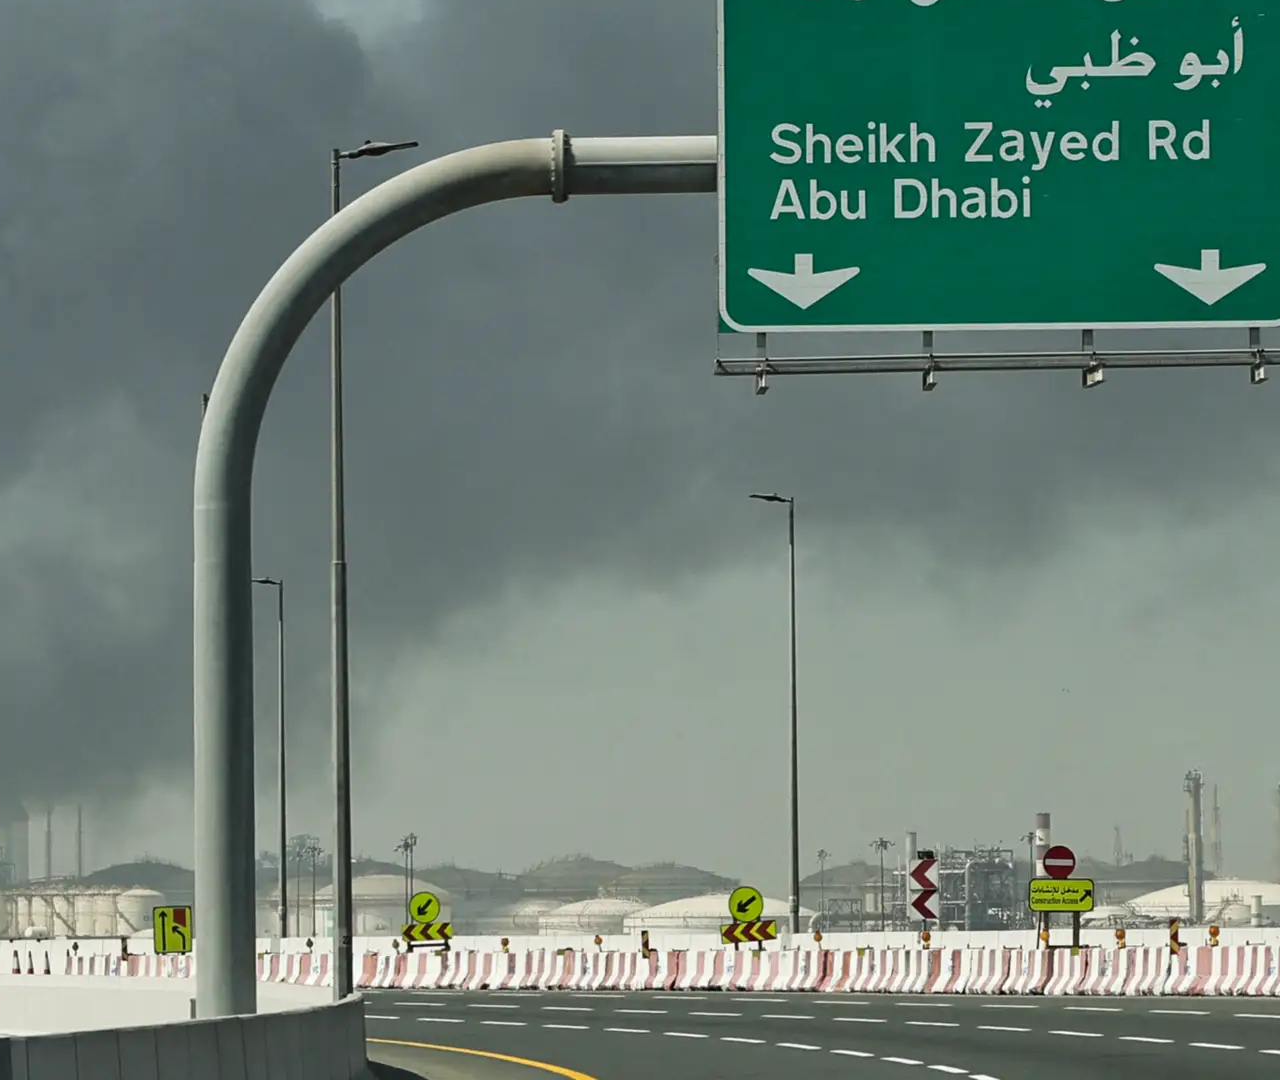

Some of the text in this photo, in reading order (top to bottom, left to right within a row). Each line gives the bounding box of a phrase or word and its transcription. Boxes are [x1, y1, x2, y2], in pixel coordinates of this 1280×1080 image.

[1025, 16, 1245, 109] أبو ظبي
[769, 119, 1211, 171] Sheikh Zayed Rd
[770, 175, 1032, 221] Abu Dhabi
